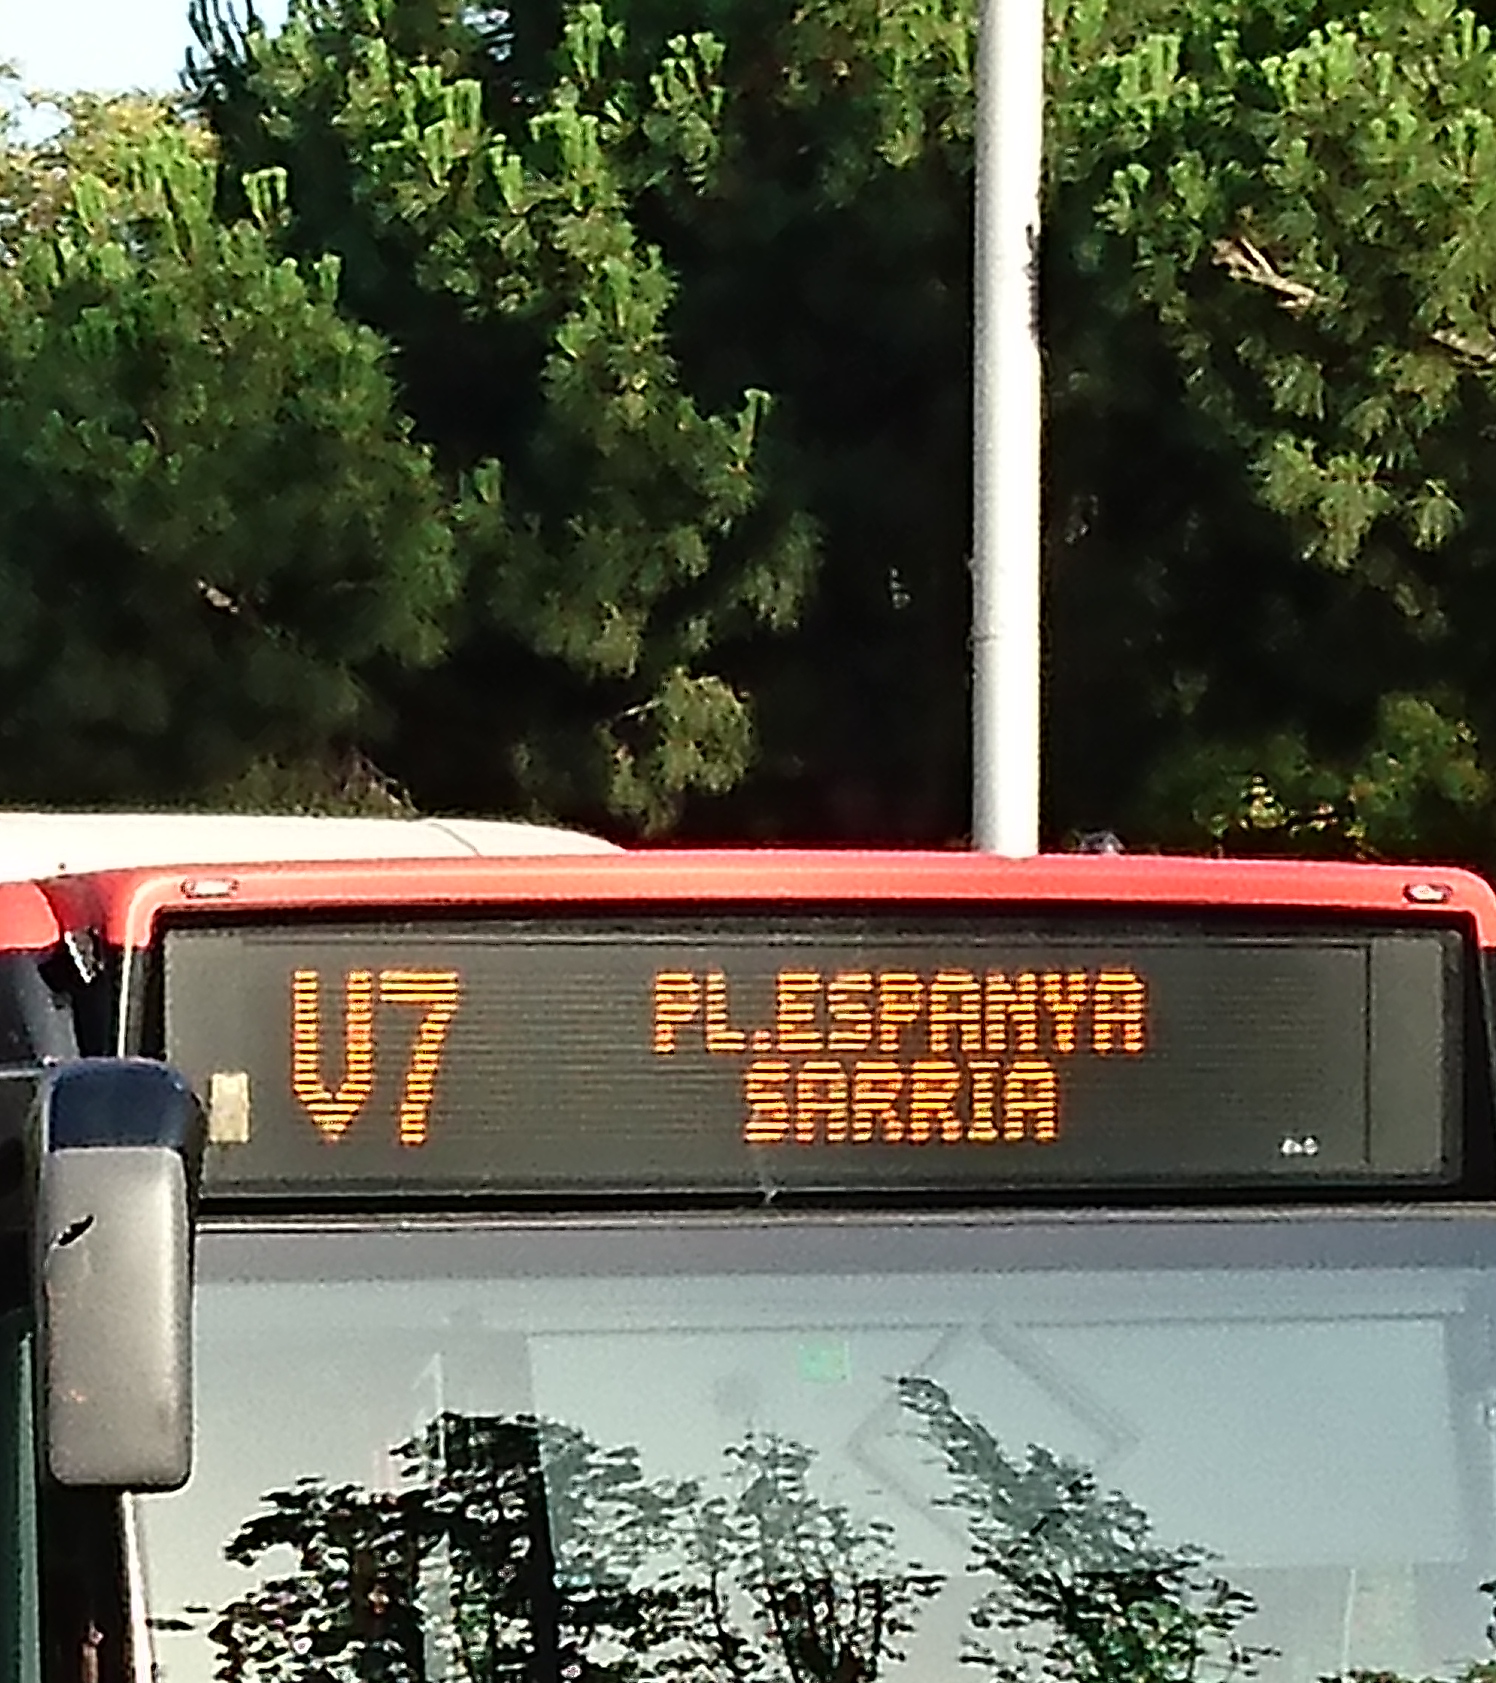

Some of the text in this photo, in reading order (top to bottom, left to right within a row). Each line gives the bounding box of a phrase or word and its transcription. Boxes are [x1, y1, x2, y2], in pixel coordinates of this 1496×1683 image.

[651, 971, 1147, 1054] PL.ESPANYA
[289, 968, 461, 1146] V7
[744, 1057, 1060, 1144] SARRIA
